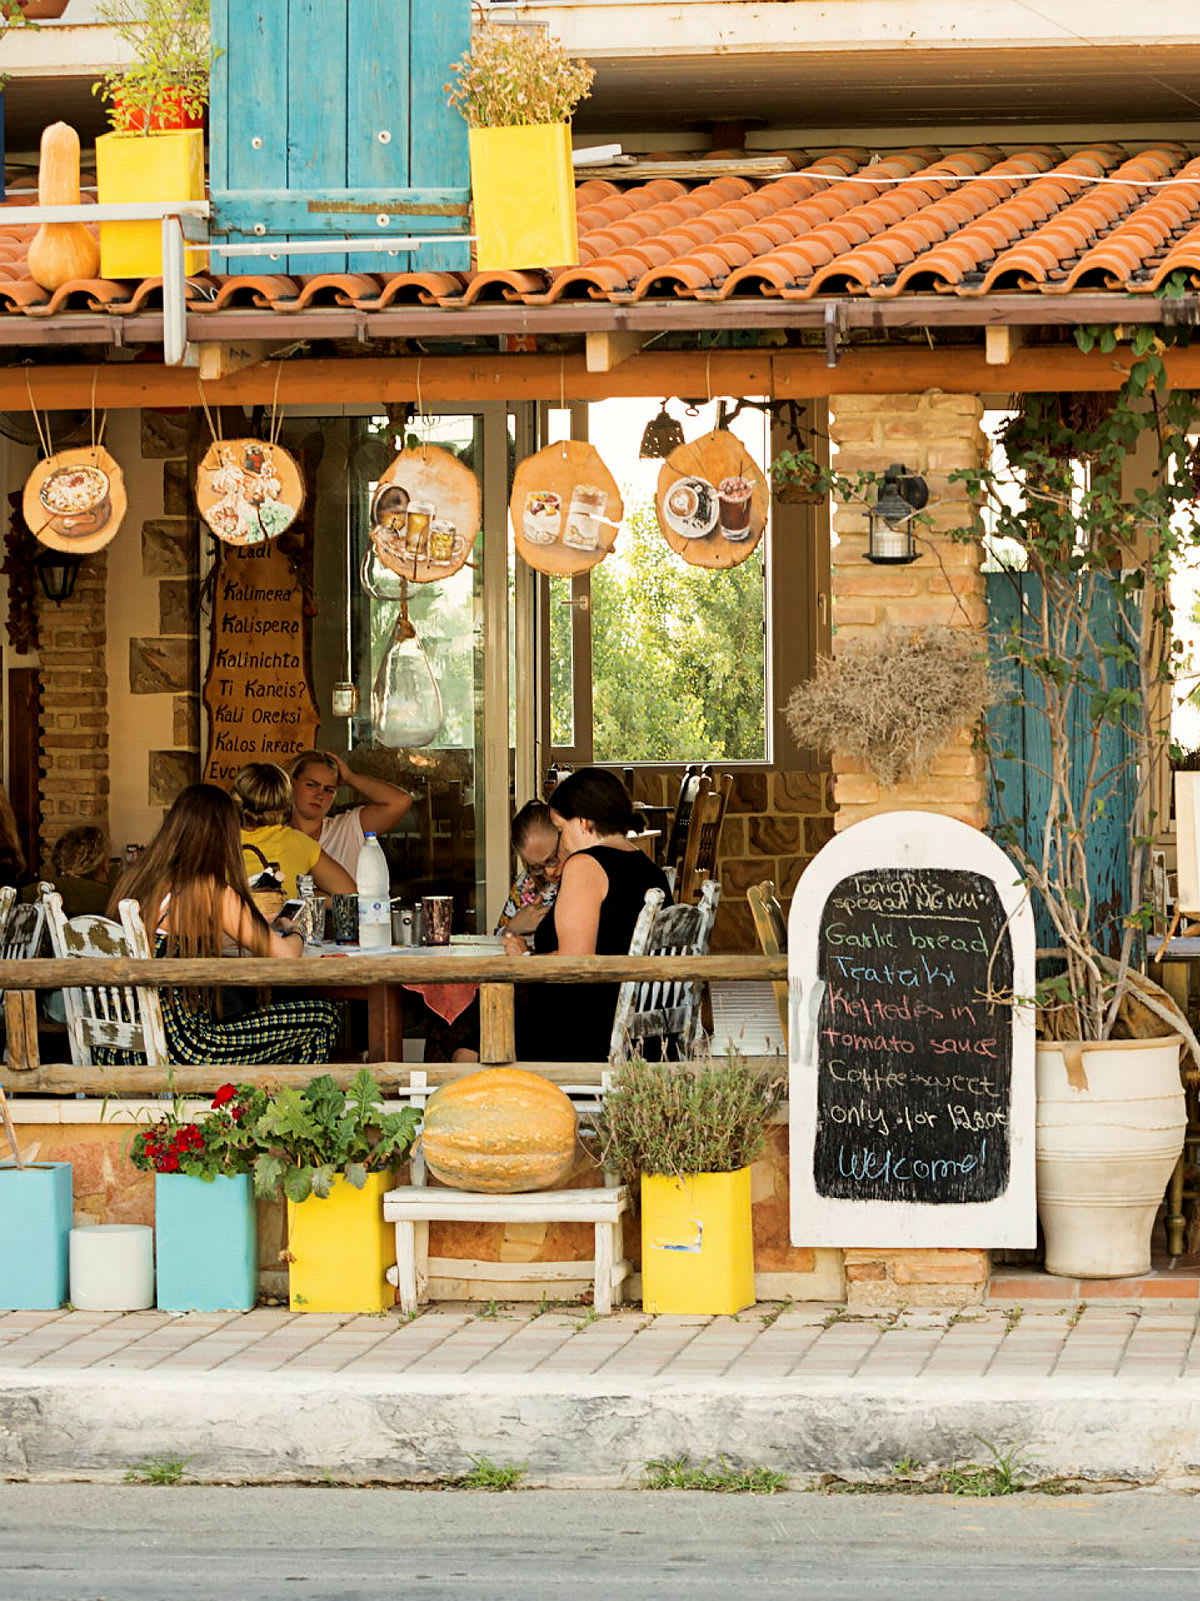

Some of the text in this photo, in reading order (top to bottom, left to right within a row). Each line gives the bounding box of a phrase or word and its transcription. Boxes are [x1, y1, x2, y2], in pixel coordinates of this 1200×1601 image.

[223, 580, 291, 601] Kalimera
[222, 613, 300, 639] Kalispera
[216, 648, 300, 669] Kalinichta
[219, 679, 233, 697] Ti
[216, 703, 244, 724] Kali
[216, 731, 256, 752] Kalos
[825, 922, 987, 957] Garlic bread
[949, 1003, 976, 1026] in
[823, 1028, 998, 1059] tomato sauce
[831, 1099, 889, 1136] only
